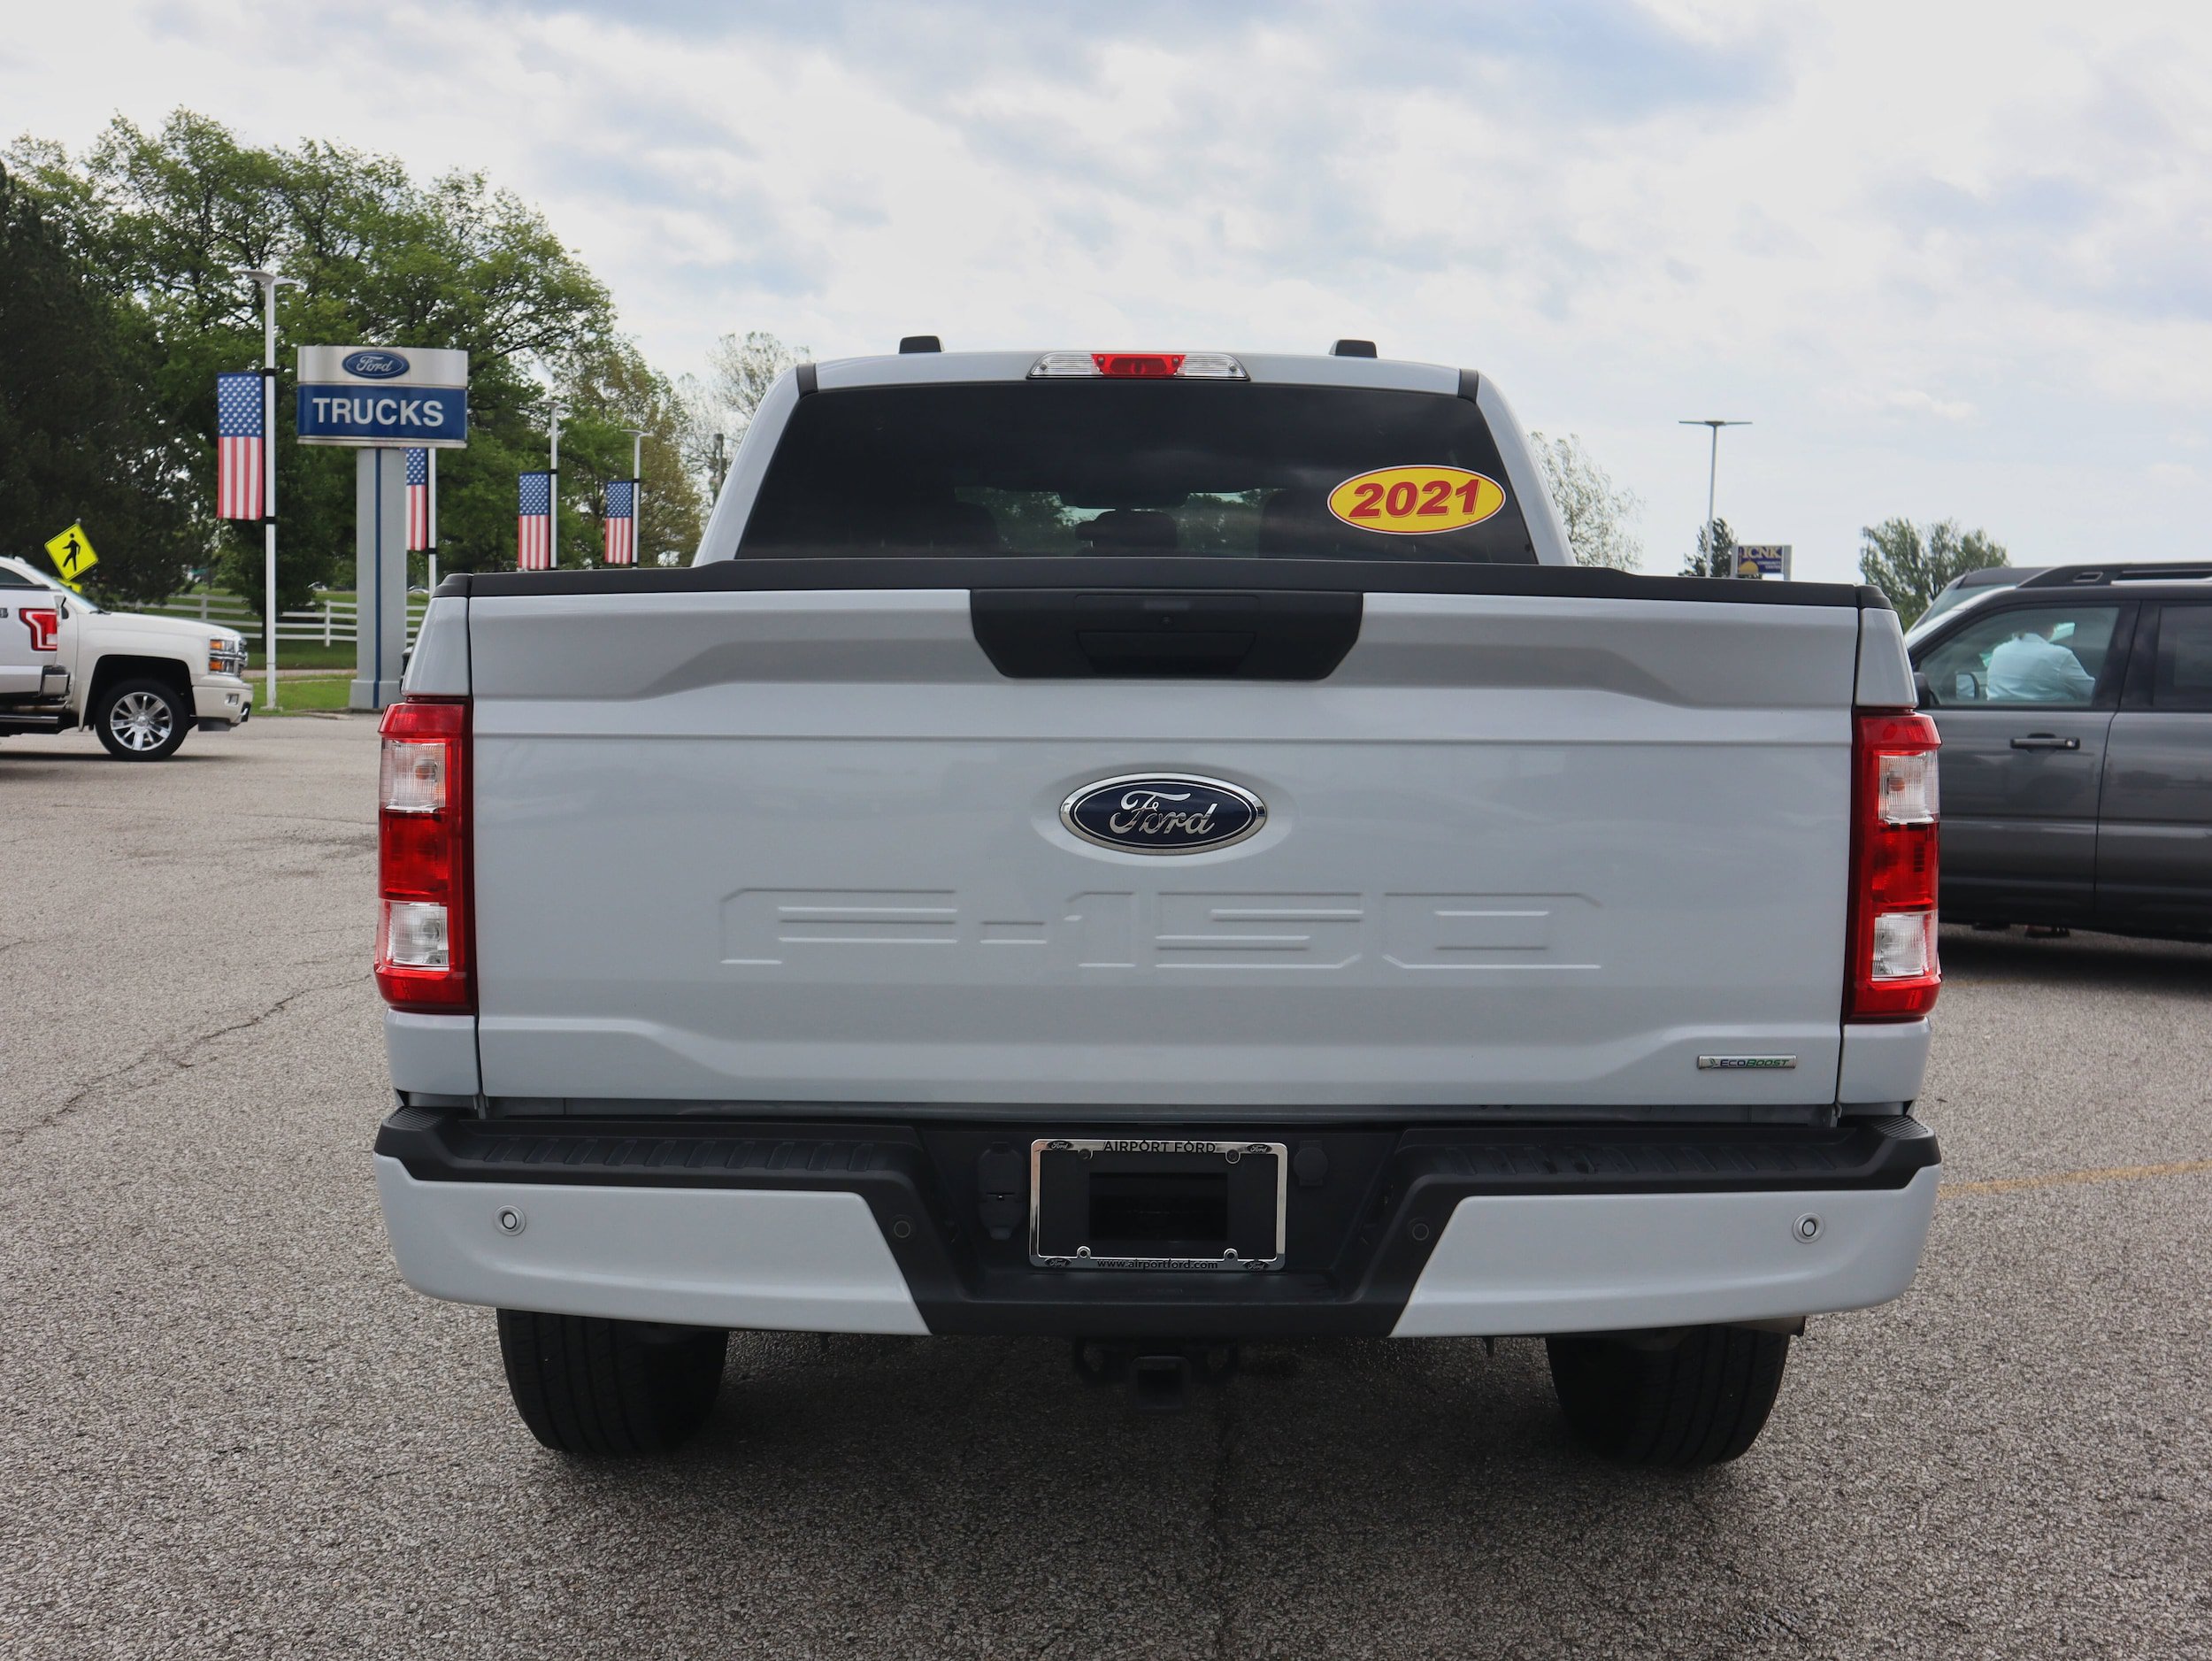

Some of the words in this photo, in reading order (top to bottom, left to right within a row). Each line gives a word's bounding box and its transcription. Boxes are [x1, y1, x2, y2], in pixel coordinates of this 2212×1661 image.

[356, 355, 394, 373] Ford
[312, 397, 444, 427] TRUCKS
[1348, 479, 1481, 519] 2021
[1109, 790, 1218, 834] Ford
[1103, 1140, 1169, 1152] AIRPORT
[1174, 1140, 1216, 1153] FORD
[1097, 1257, 1218, 1269] www.airportford.com
